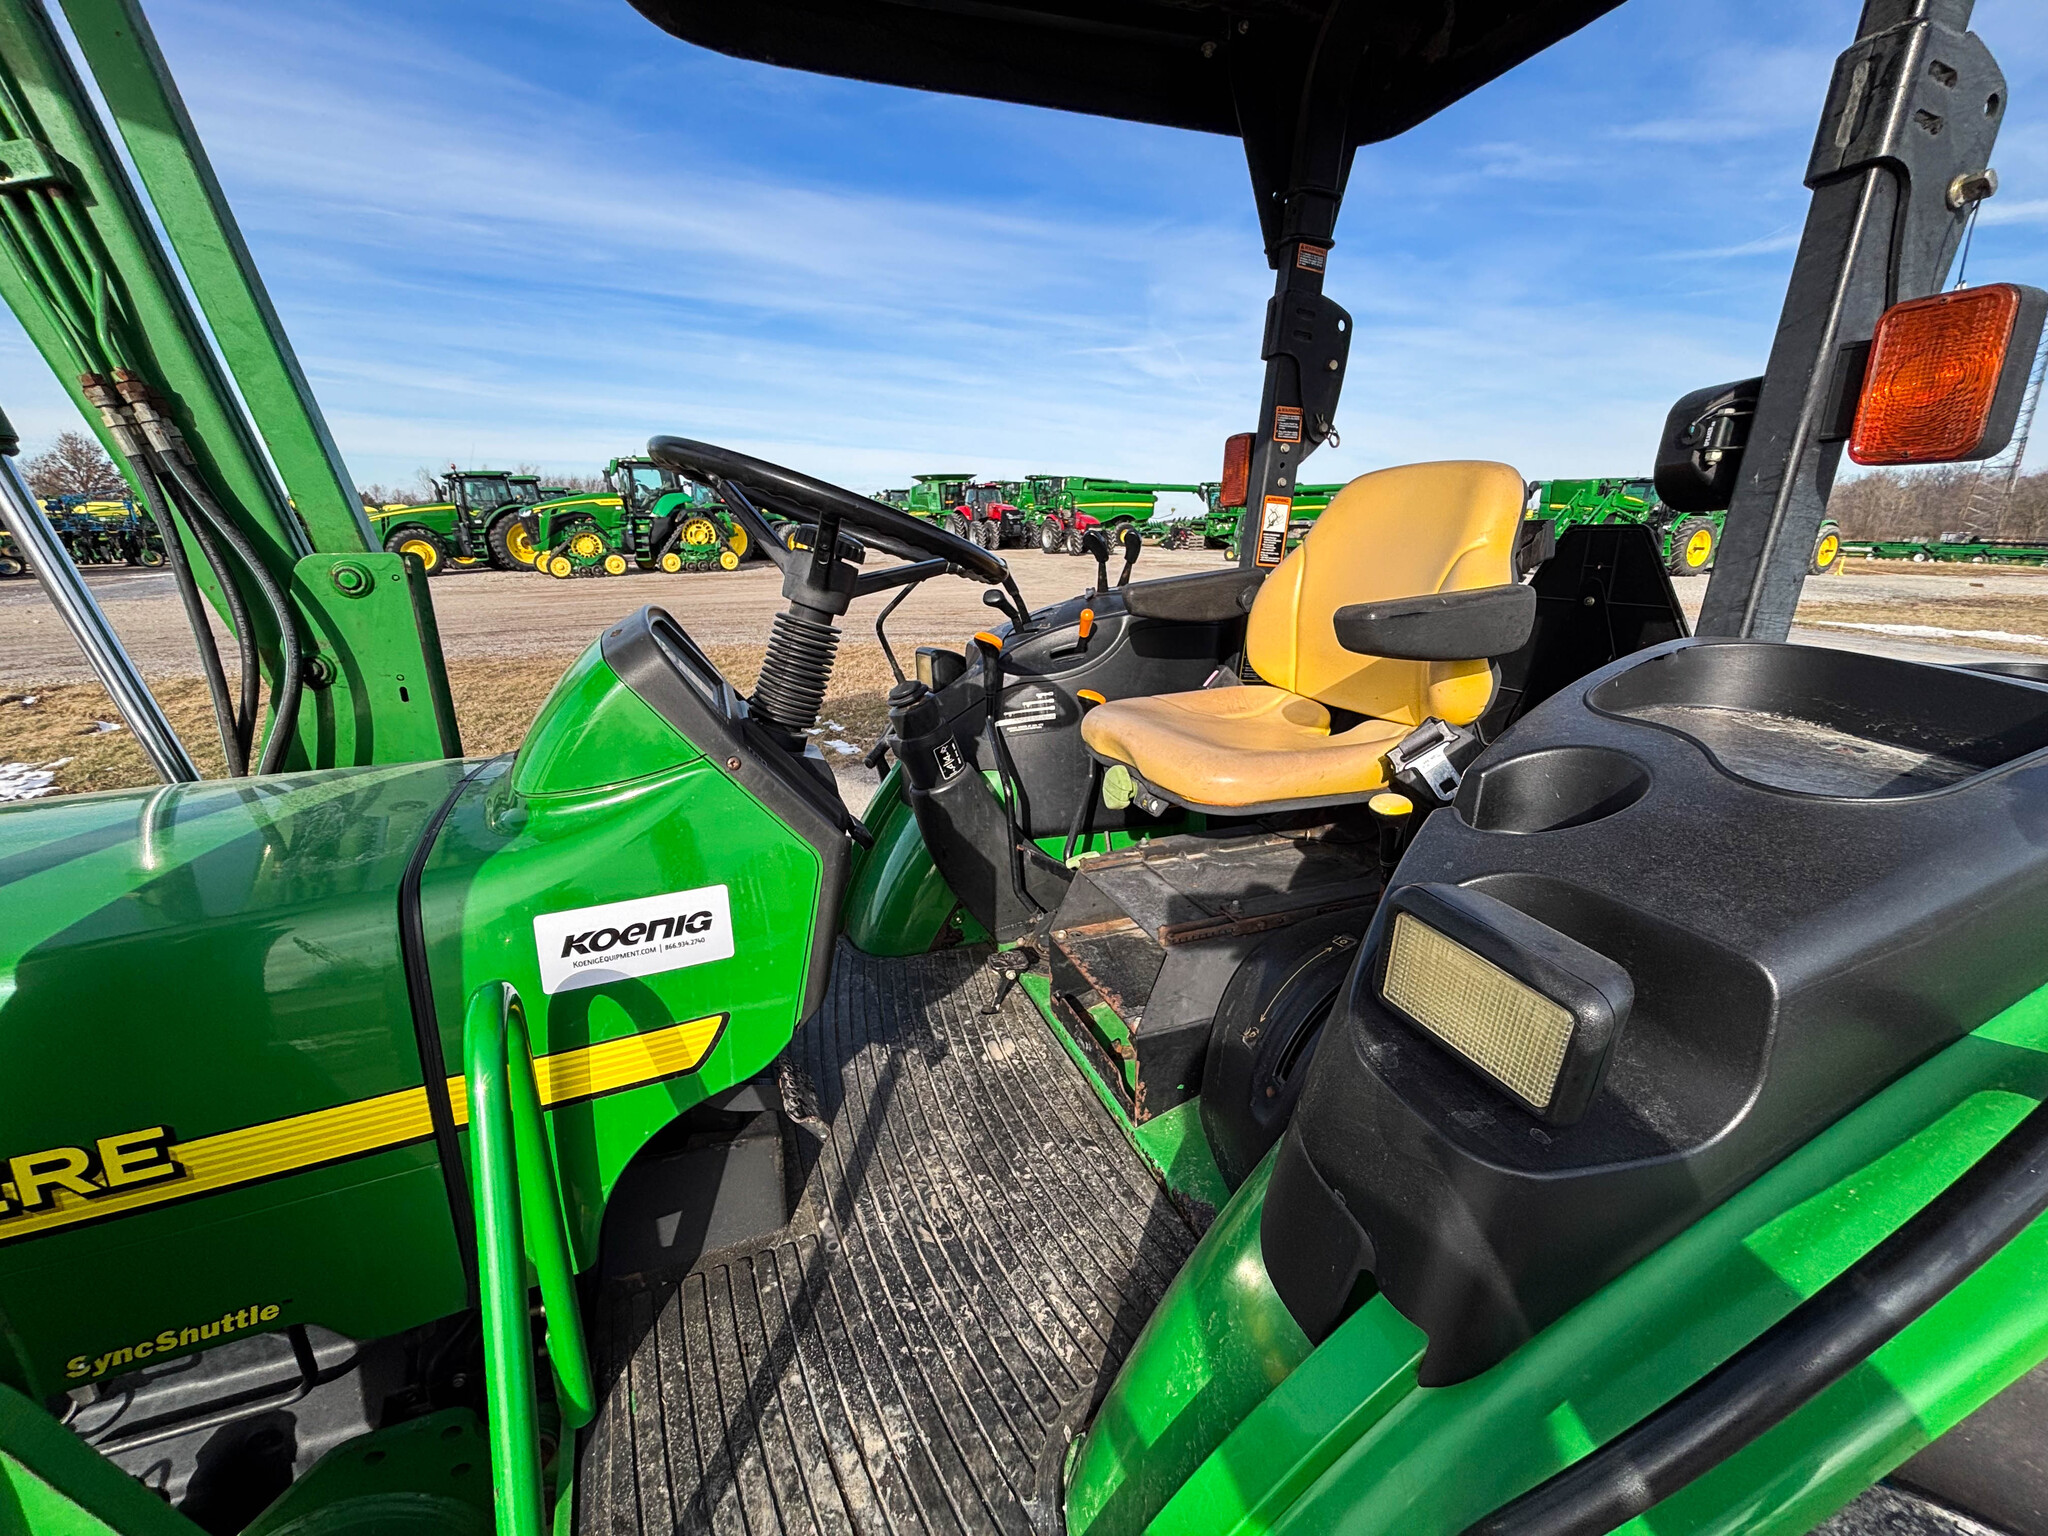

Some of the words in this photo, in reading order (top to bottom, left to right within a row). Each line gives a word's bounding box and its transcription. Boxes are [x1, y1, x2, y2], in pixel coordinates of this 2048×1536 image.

[664, 937, 706, 951] 866.934.2740
[0, 1126, 175, 1212] RE
[65, 1303, 281, 1379] SyncShuttle
